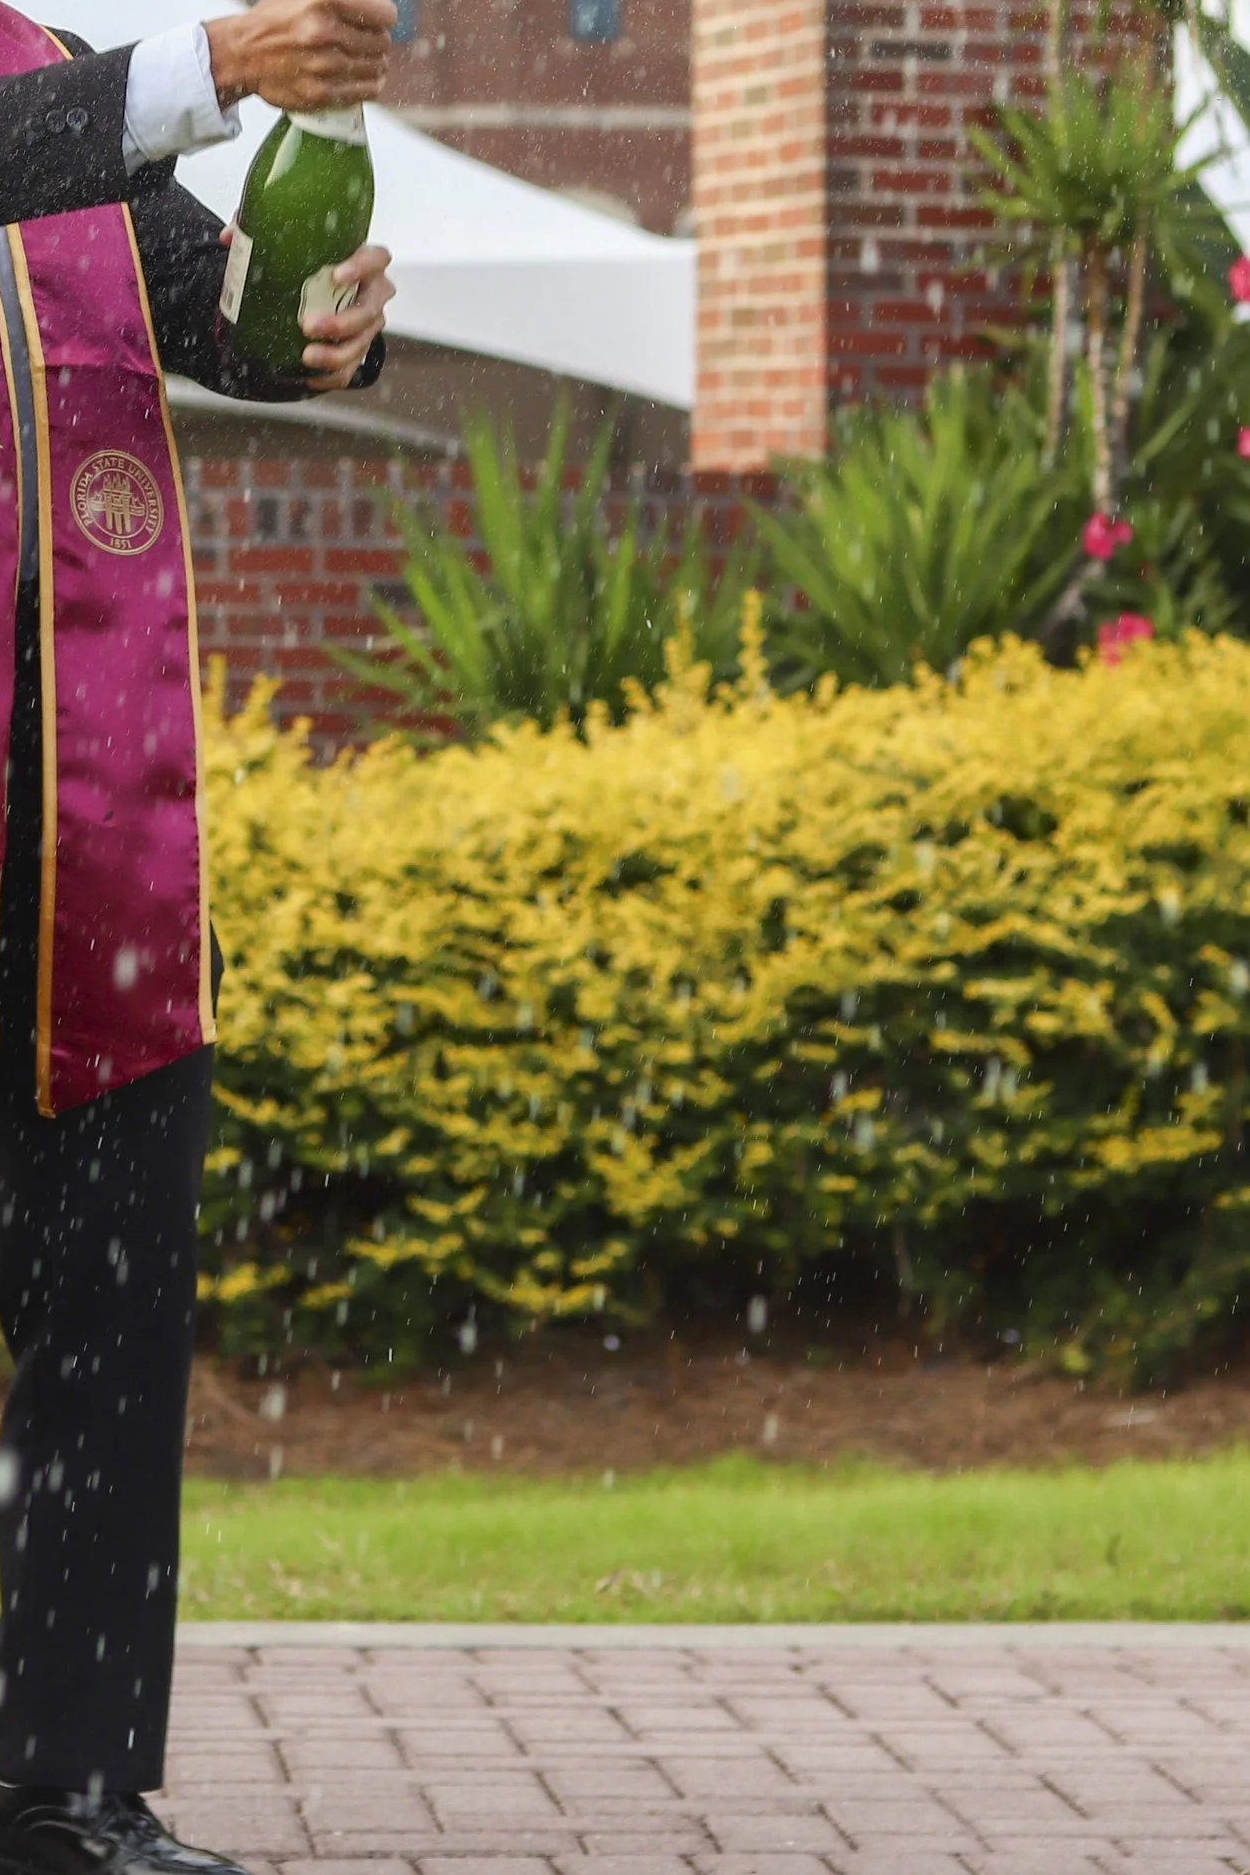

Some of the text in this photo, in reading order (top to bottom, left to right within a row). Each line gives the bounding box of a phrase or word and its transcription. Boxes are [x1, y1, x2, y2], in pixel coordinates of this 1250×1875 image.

[76, 457, 159, 534] FLORIDA STATE UNIVERSITY
[110, 537, 132, 549] 1851
